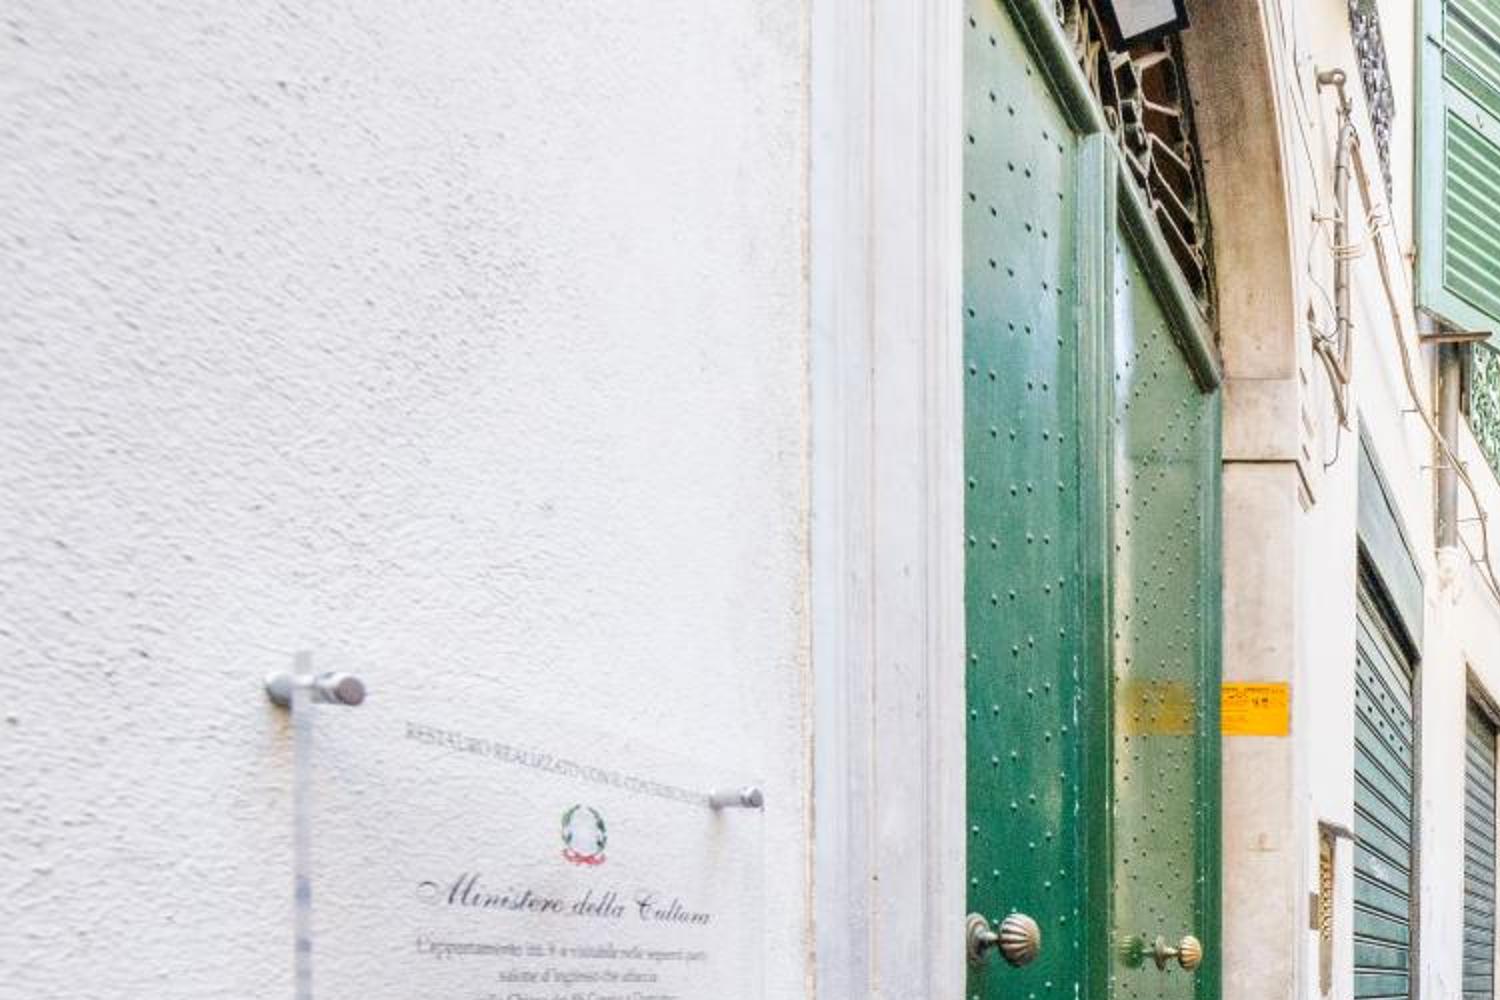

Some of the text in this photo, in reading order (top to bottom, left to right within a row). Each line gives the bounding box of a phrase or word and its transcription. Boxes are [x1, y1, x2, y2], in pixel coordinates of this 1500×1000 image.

[418, 872, 712, 926] Ministero della Cultura
